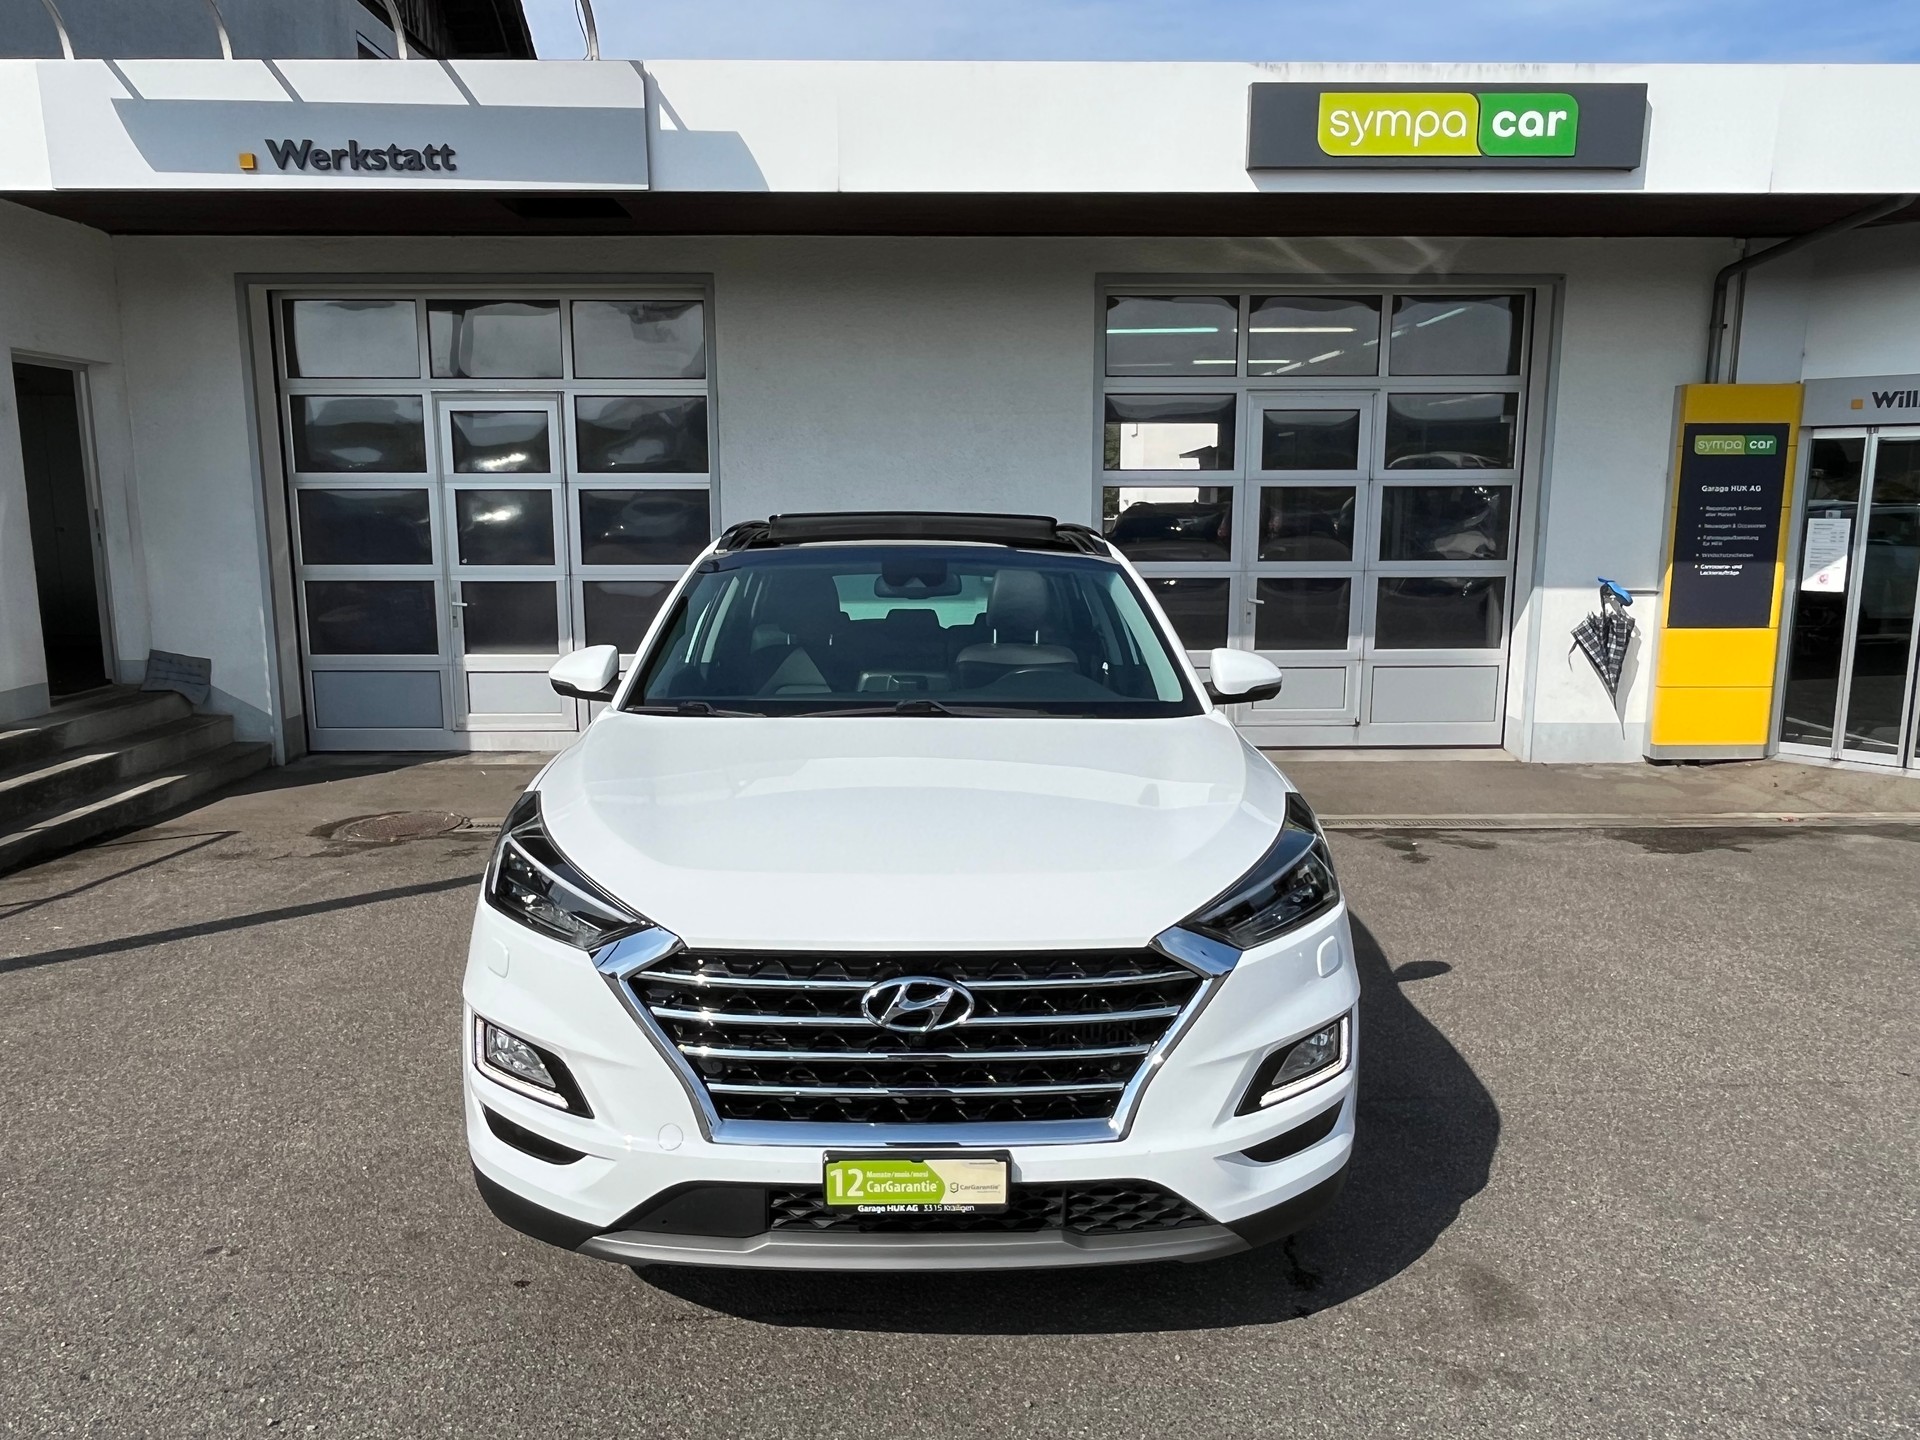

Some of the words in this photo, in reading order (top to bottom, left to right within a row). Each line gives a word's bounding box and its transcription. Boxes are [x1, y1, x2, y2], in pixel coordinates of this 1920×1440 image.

[1329, 109, 1468, 147] sympa
[1492, 109, 1568, 138] car
[264, 138, 457, 171] Werkstatt
[1871, 390, 1920, 409] Will
[1697, 440, 1743, 452] sympa
[1749, 440, 1774, 449] car
[1701, 485, 1729, 493] Garage
[830, 1168, 864, 1197] 12
[866, 1180, 937, 1193] CarGarantie
[857, 1205, 886, 1213] Garage
[906, 1204, 919, 1212] AG
[923, 1204, 943, 1212] 3315
